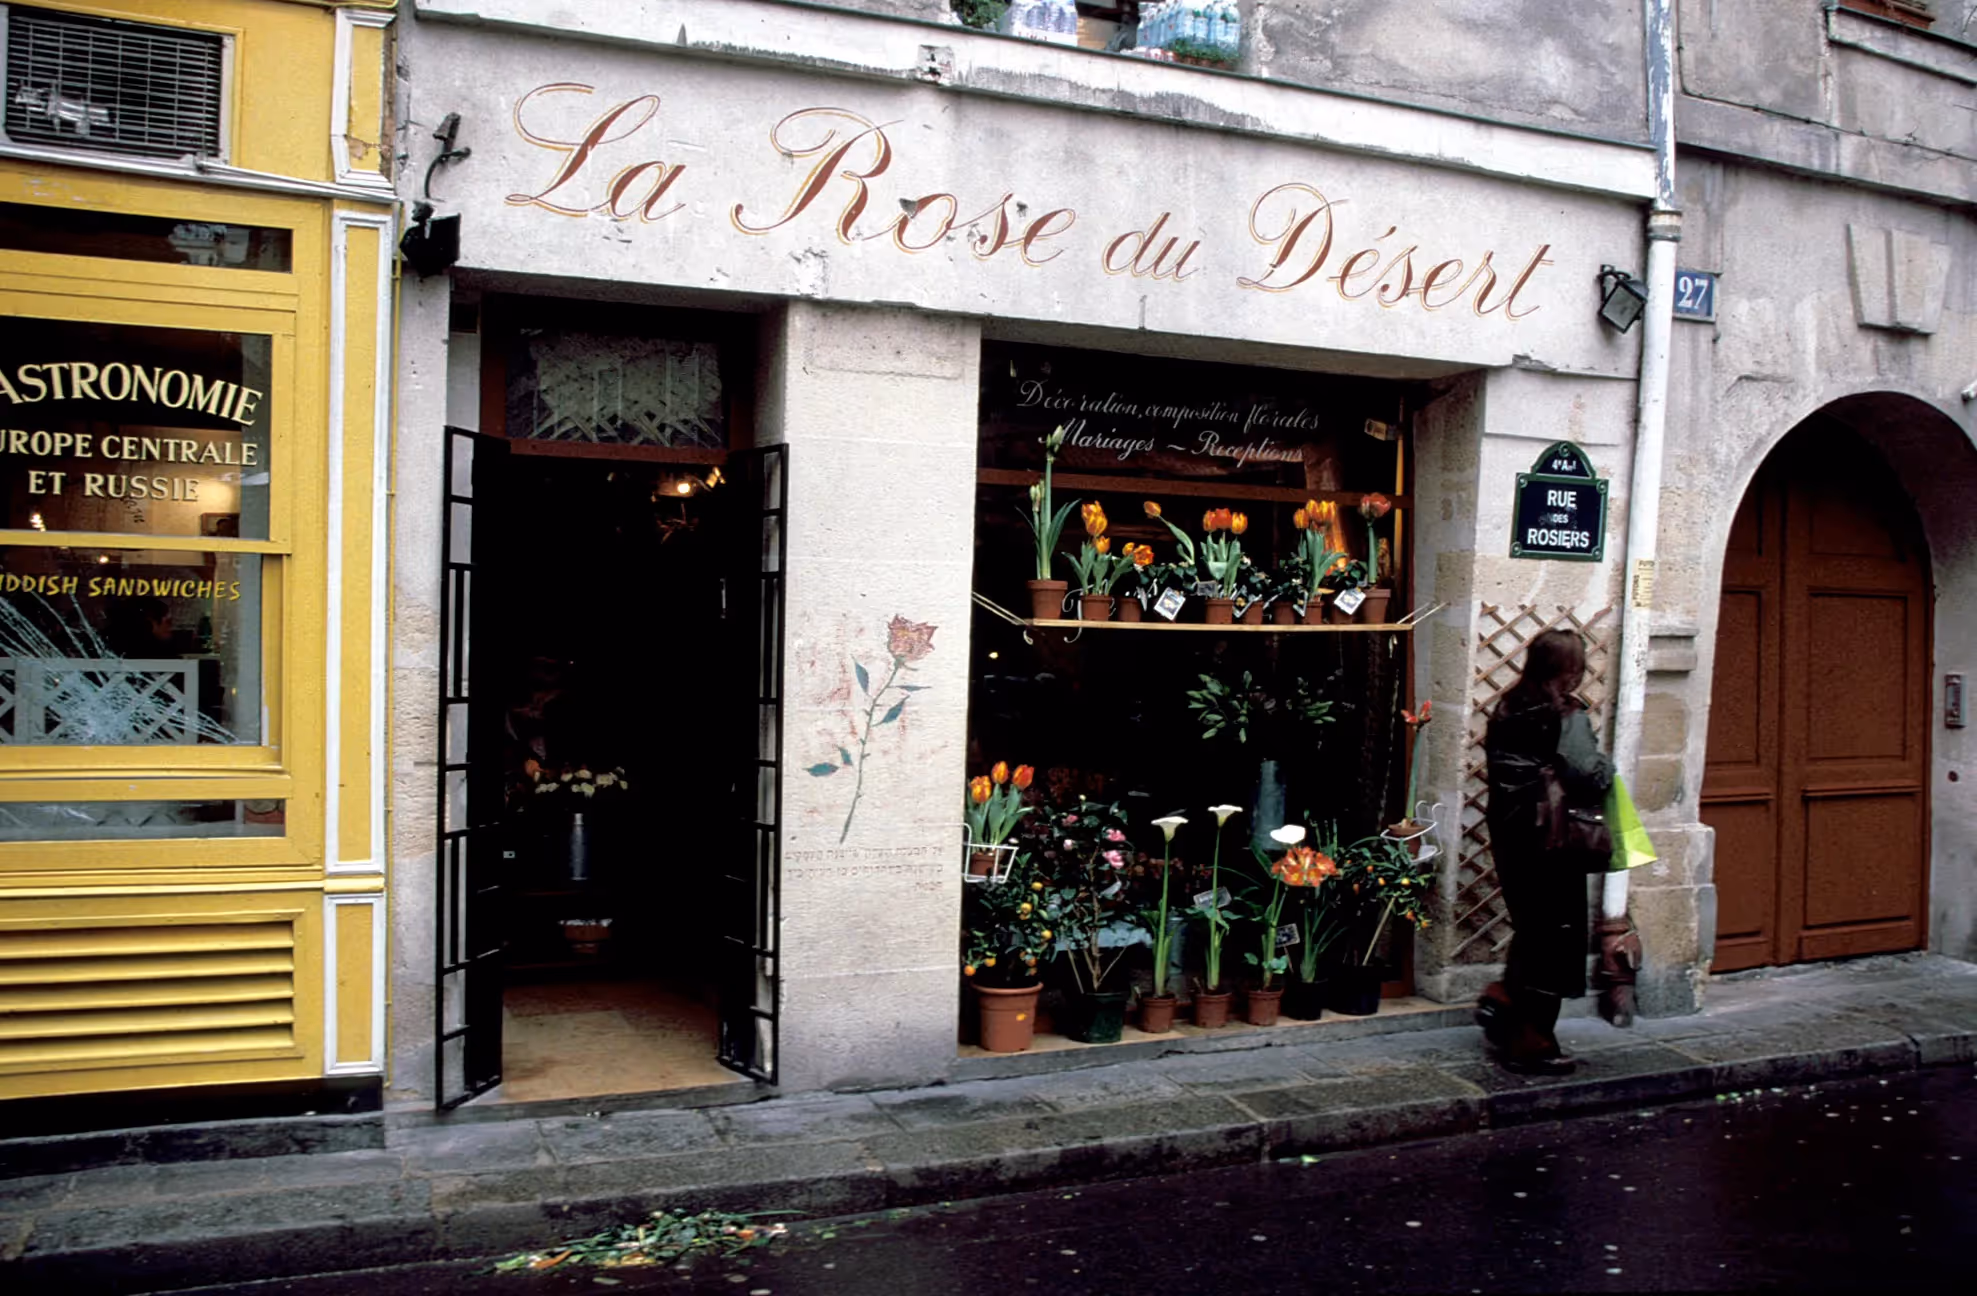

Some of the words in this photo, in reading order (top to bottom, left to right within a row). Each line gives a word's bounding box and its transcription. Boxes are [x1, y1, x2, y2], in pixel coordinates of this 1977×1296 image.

[503, 81, 686, 223] La
[730, 107, 1077, 266] Rose
[1102, 211, 1200, 280] du
[1236, 182, 1555, 321] Désert
[1678, 276, 1709, 309] 27
[101, 435, 258, 467] CENTRALE
[1037, 417, 1155, 461] Mariages
[28, 470, 66, 495] ET
[84, 473, 200, 502] RUSSIE
[1547, 489, 1577, 508] RUE
[1552, 514, 1569, 523] DES
[1527, 528, 1590, 548] ROSIERS
[88, 576, 241, 601] SANDWICHES
